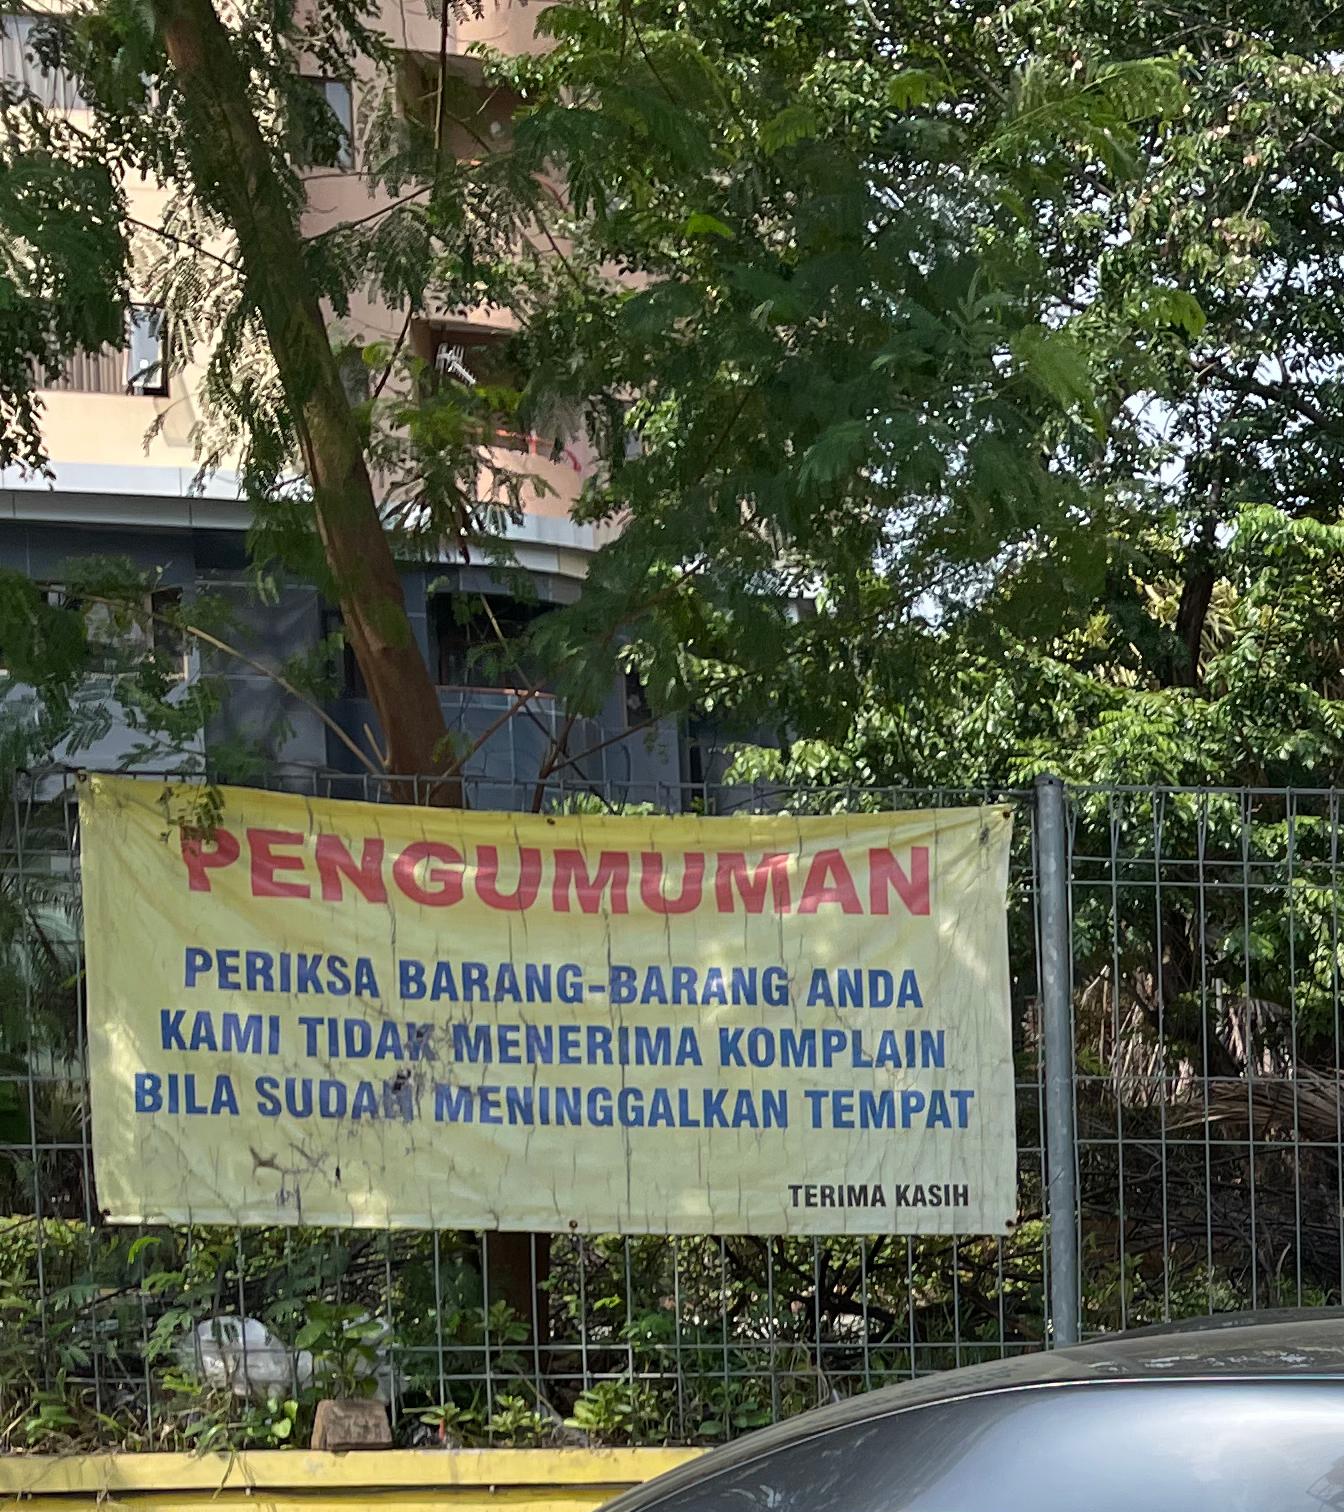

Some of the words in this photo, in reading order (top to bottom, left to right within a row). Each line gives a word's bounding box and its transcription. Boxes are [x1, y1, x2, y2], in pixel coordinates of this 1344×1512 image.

[179, 825, 931, 916] PENGUMUMAN
[184, 946, 380, 998] PERIKSA
[399, 959, 789, 1006] BARANG-BARANG
[806, 968, 923, 1008] ANDA
[160, 1009, 280, 1055] KAMI
[298, 1016, 438, 1061] TIDAK
[452, 1023, 703, 1067] MENERIMA
[719, 1027, 946, 1069] KOMPLAIN
[135, 1072, 240, 1115] BILA
[255, 1076, 414, 1122] SUDAH
[435, 1083, 789, 1129] MENINGGALKAN
[804, 1090, 975, 1129] TEMPAT
[788, 1184, 885, 1208] TERIMA
[896, 1184, 969, 1207] KASIH
